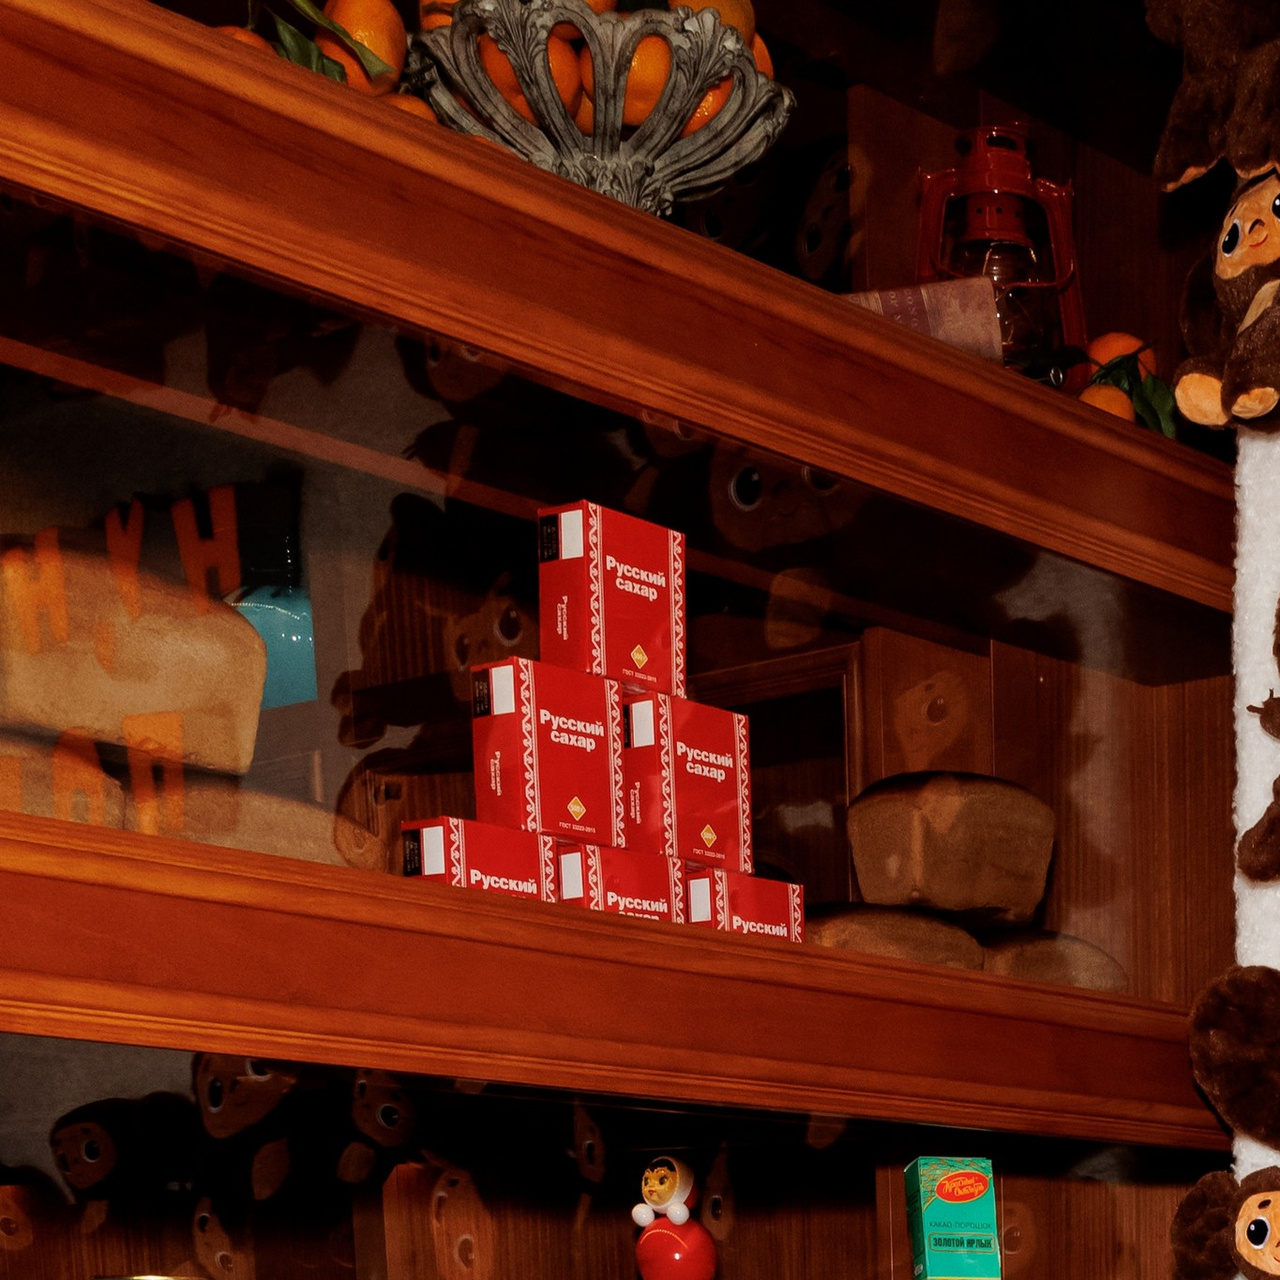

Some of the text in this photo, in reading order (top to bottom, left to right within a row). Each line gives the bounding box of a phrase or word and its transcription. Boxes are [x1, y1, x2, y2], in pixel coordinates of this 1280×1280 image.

[606, 555, 666, 587] Русский
[615, 578, 658, 602] сахар
[540, 709, 605, 737] Русский
[550, 730, 596, 752] сахар
[677, 741, 733, 768] Русский
[686, 762, 725, 783] сахар
[470, 869, 537, 894] Русский
[607, 892, 668, 914] Русский
[732, 916, 788, 937] Русский
[930, 1221, 992, 1229] КАКАО-ПОРОШОК
[933, 1236, 992, 1248] ЗОЛОТОЙ ЯРЛЫК
